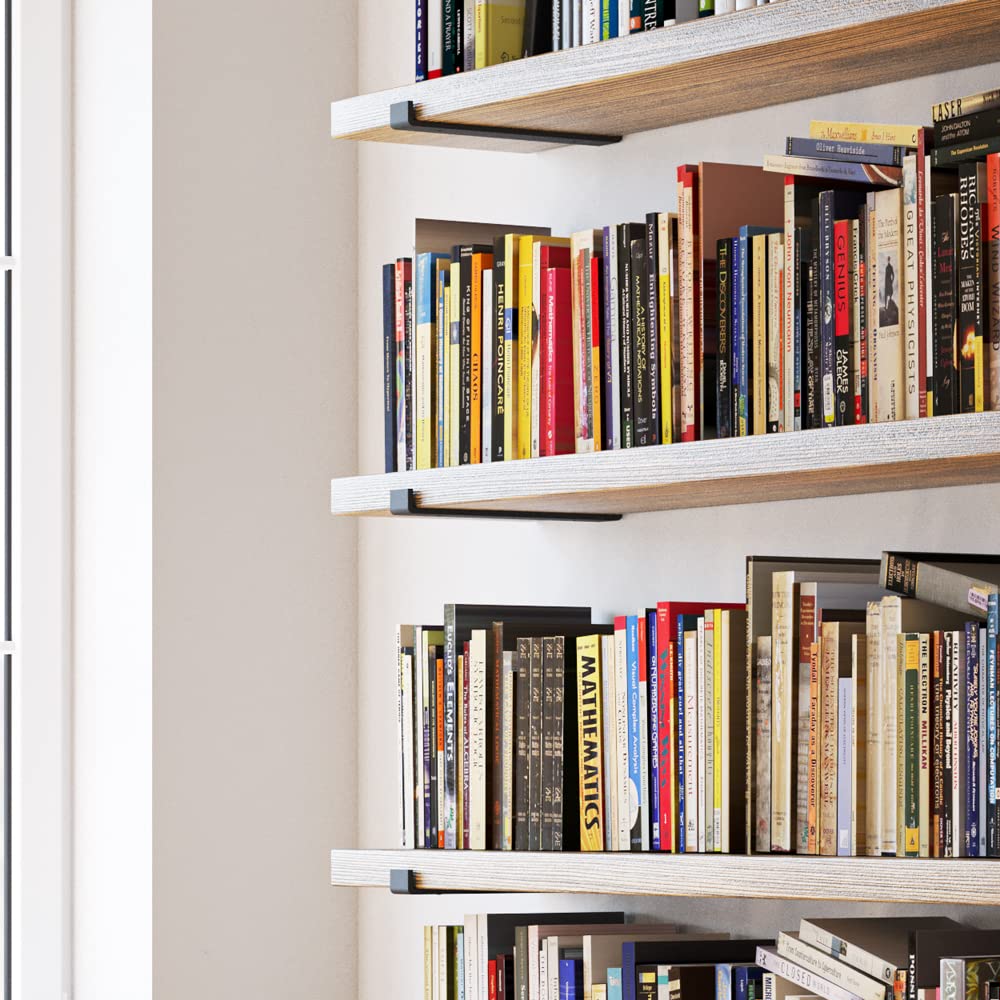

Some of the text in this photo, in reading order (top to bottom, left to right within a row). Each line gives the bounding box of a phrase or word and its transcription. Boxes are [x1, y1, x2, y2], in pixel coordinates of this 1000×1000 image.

[932, 98, 962, 122] LASER
[816, 142, 834, 153] Oliver
[960, 176, 968, 261] RHODES
[837, 235, 845, 313] GENIUS
[991, 225, 1000, 352] WIND WIZARD
[642, 358, 647, 370] OF
[908, 281, 916, 395] PHYSICISTS
[497, 336, 505, 415] POINCARÉ
[581, 655, 600, 831] MATHEMATICS
[811, 735, 816, 746] as
[990, 734, 996, 746] ON
[781, 961, 811, 987] CLOSED
